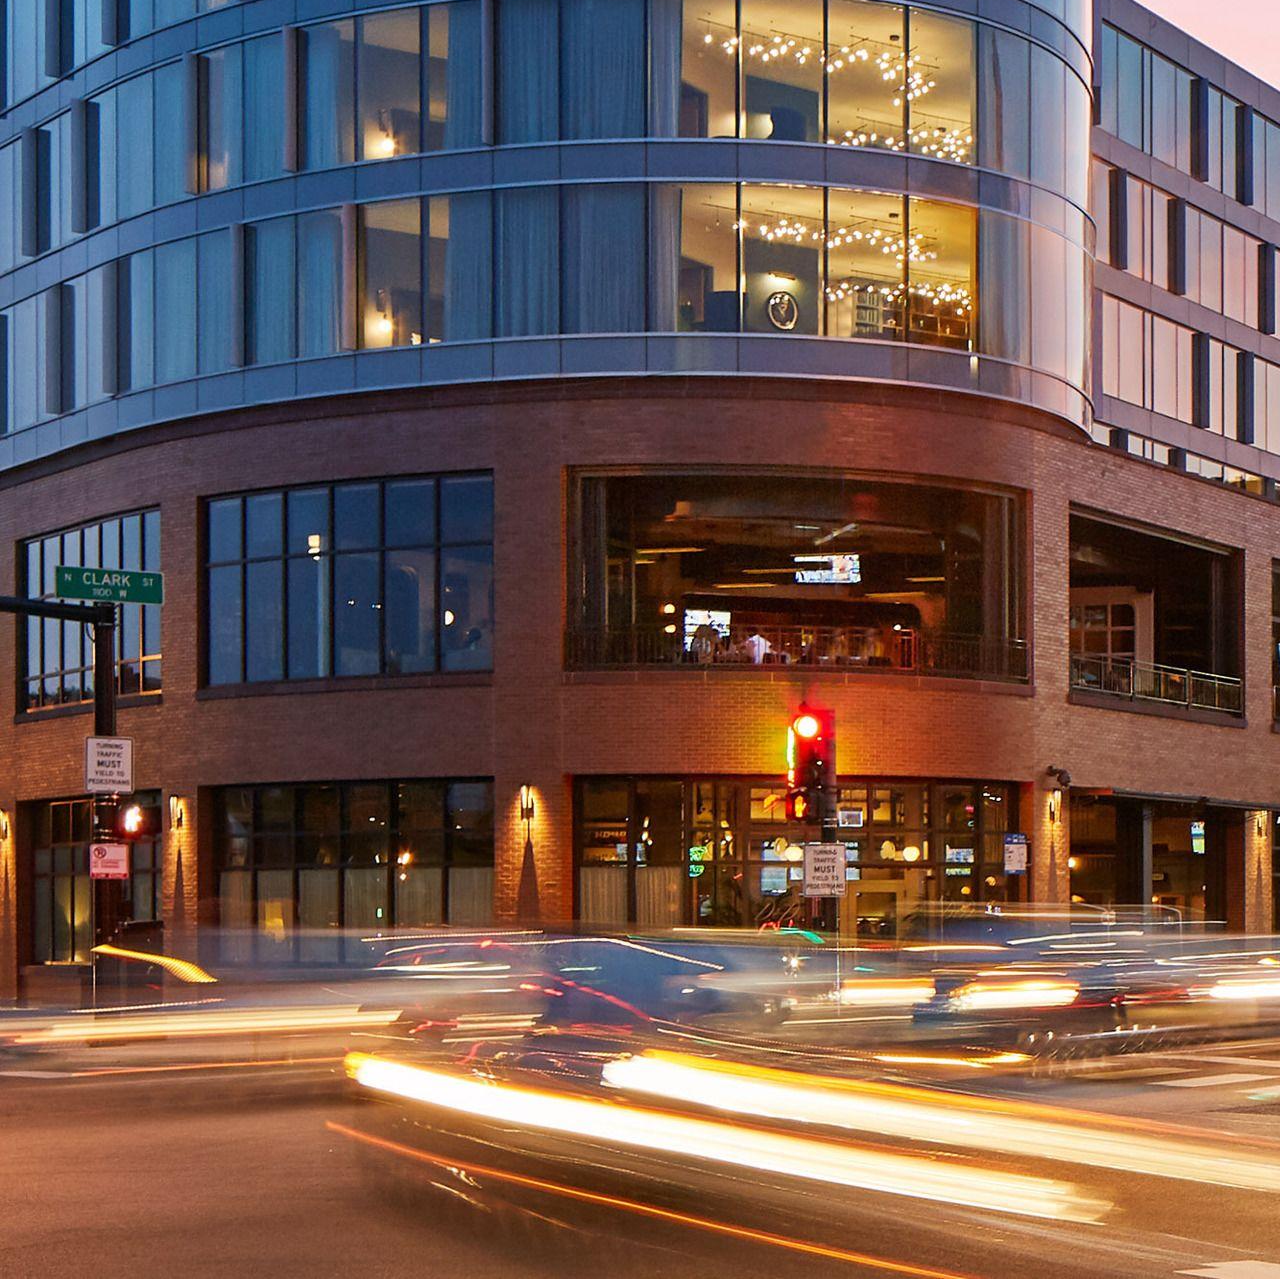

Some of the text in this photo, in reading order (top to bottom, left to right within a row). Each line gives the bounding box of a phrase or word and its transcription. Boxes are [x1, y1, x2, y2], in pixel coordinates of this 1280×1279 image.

[64, 572, 154, 587] N CLARK ST
[97, 760, 121, 769] MUST
[814, 865, 835, 873] MUST
